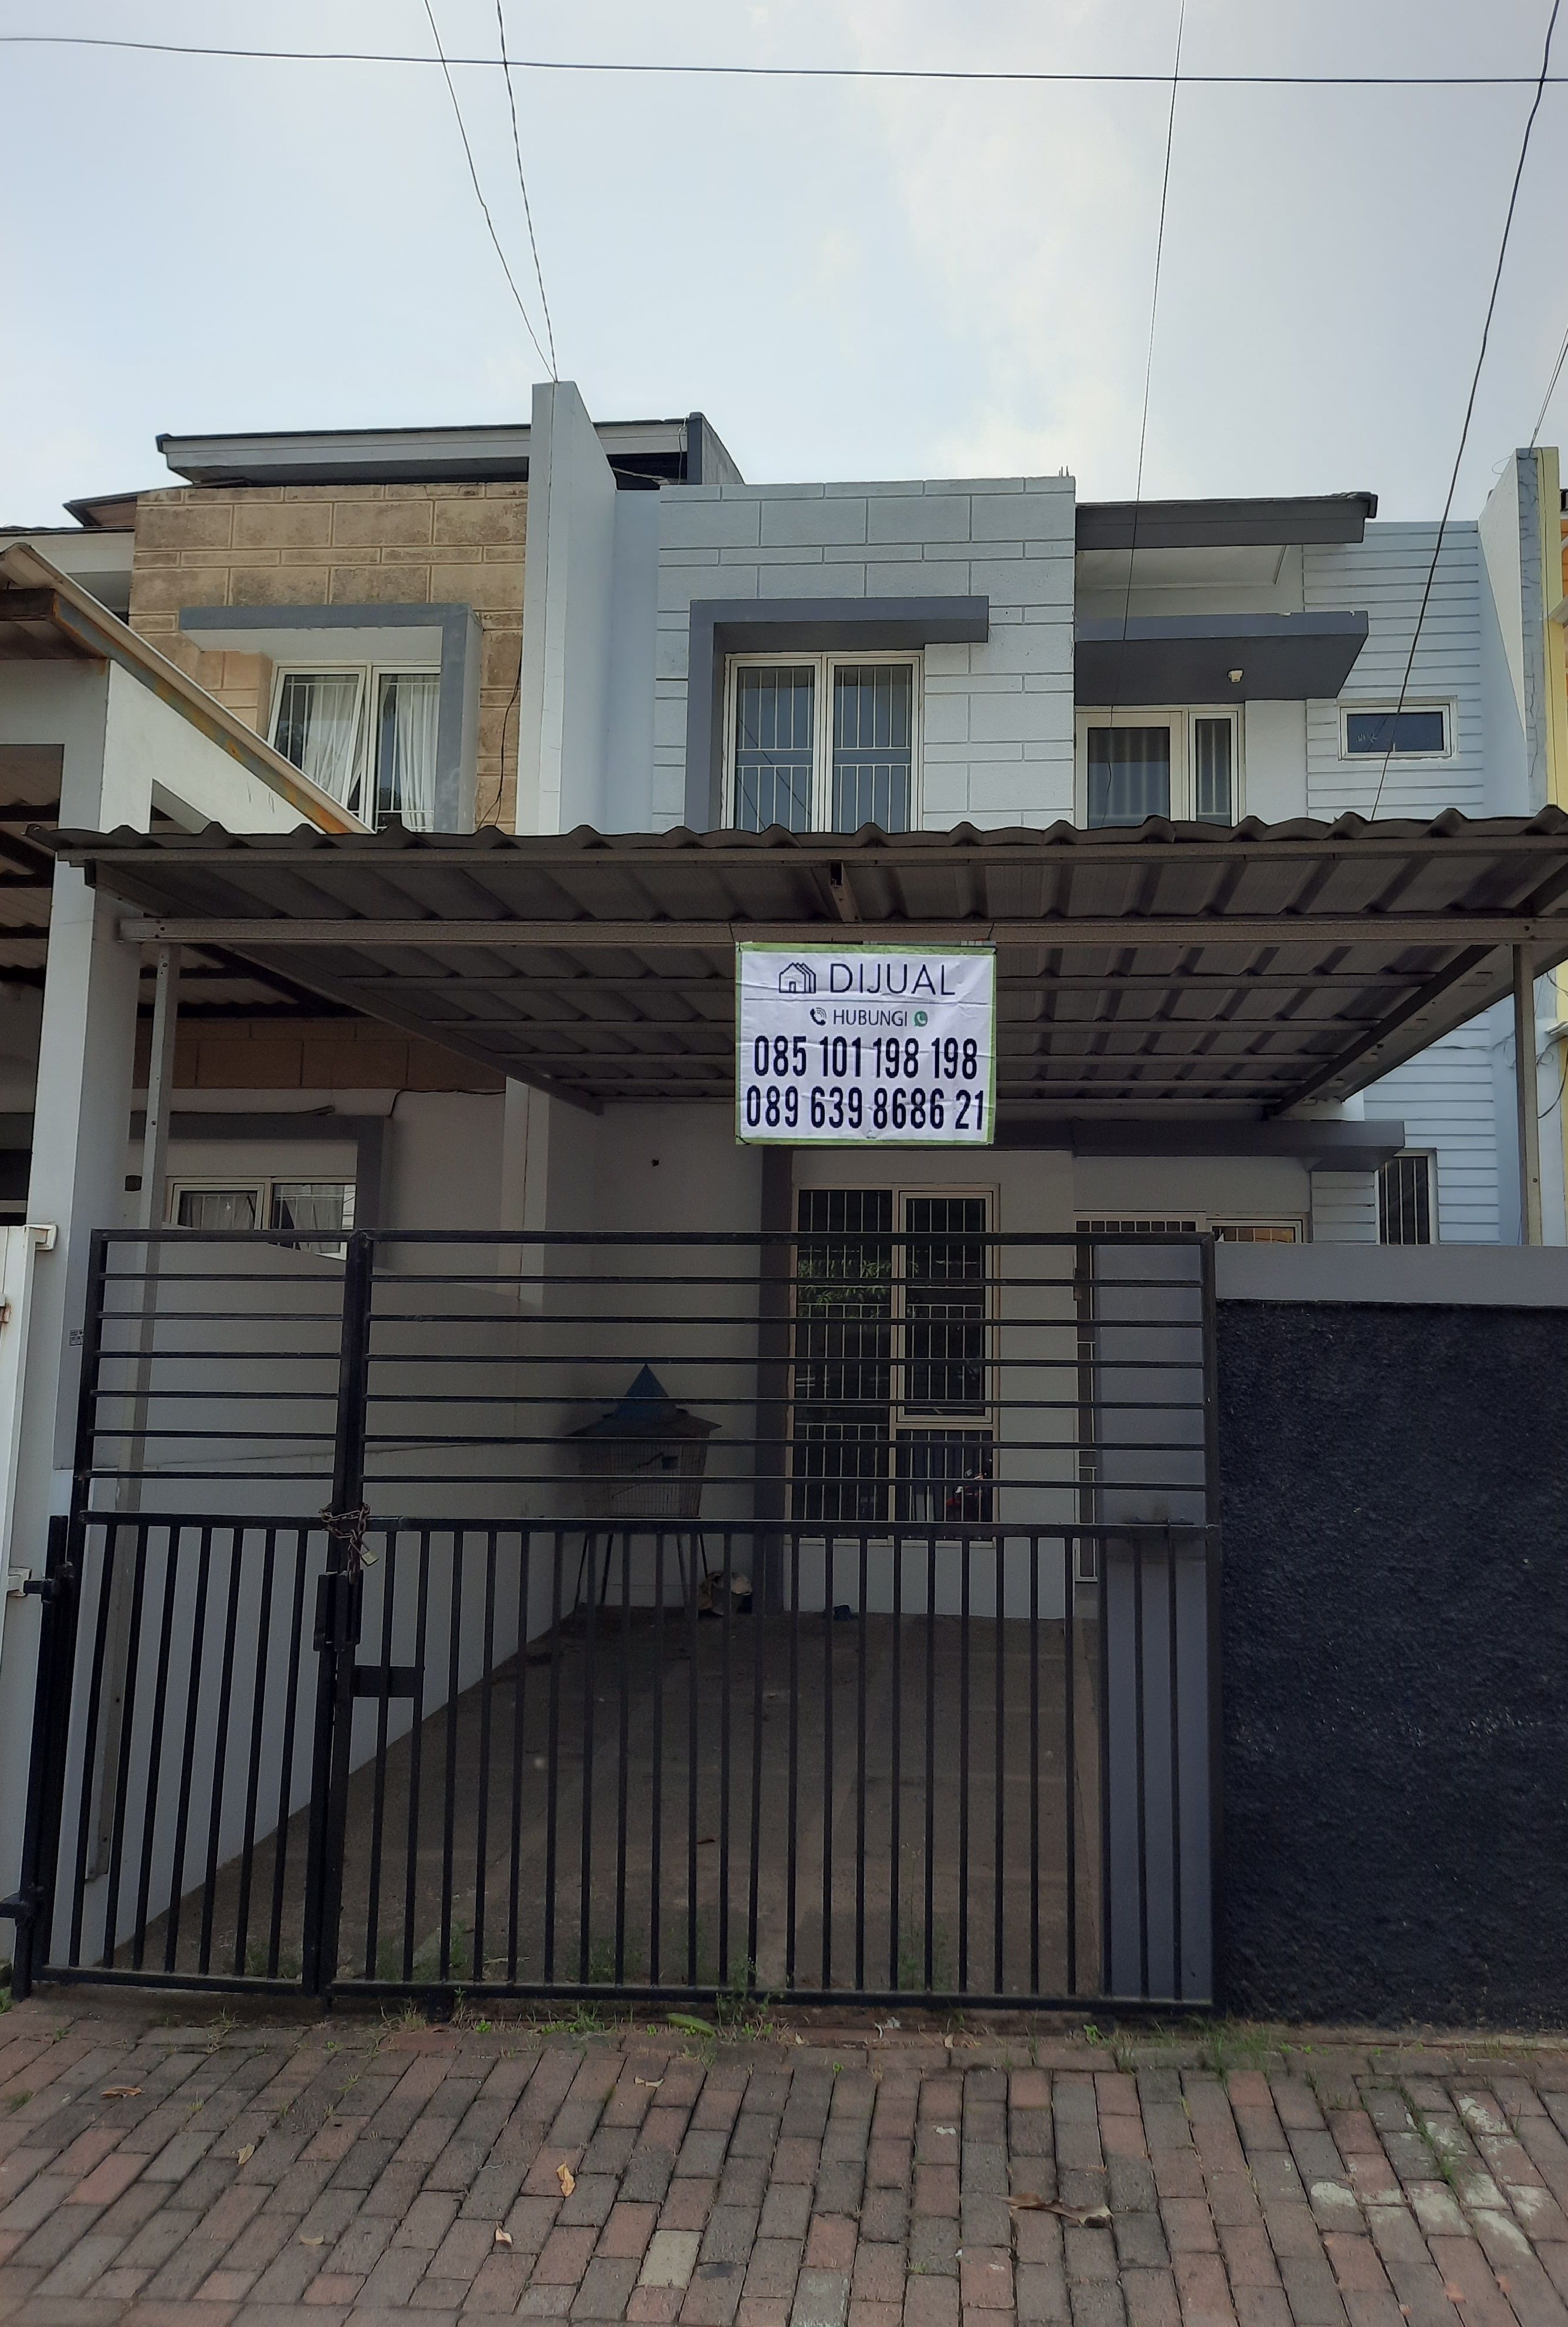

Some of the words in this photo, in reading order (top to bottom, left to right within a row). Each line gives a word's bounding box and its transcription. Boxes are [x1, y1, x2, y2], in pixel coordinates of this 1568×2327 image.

[829, 963, 956, 995] DIJUAL
[833, 1009, 907, 1027] HUBUNGI
[754, 1035, 807, 1077] 085
[819, 1036, 862, 1078] 101
[872, 1037, 919, 1079] 198
[931, 1037, 978, 1080] 198
[746, 1085, 799, 1127] 089
[810, 1086, 862, 1129] 639
[873, 1087, 945, 1130] 8686
[954, 1089, 984, 1131] 21
